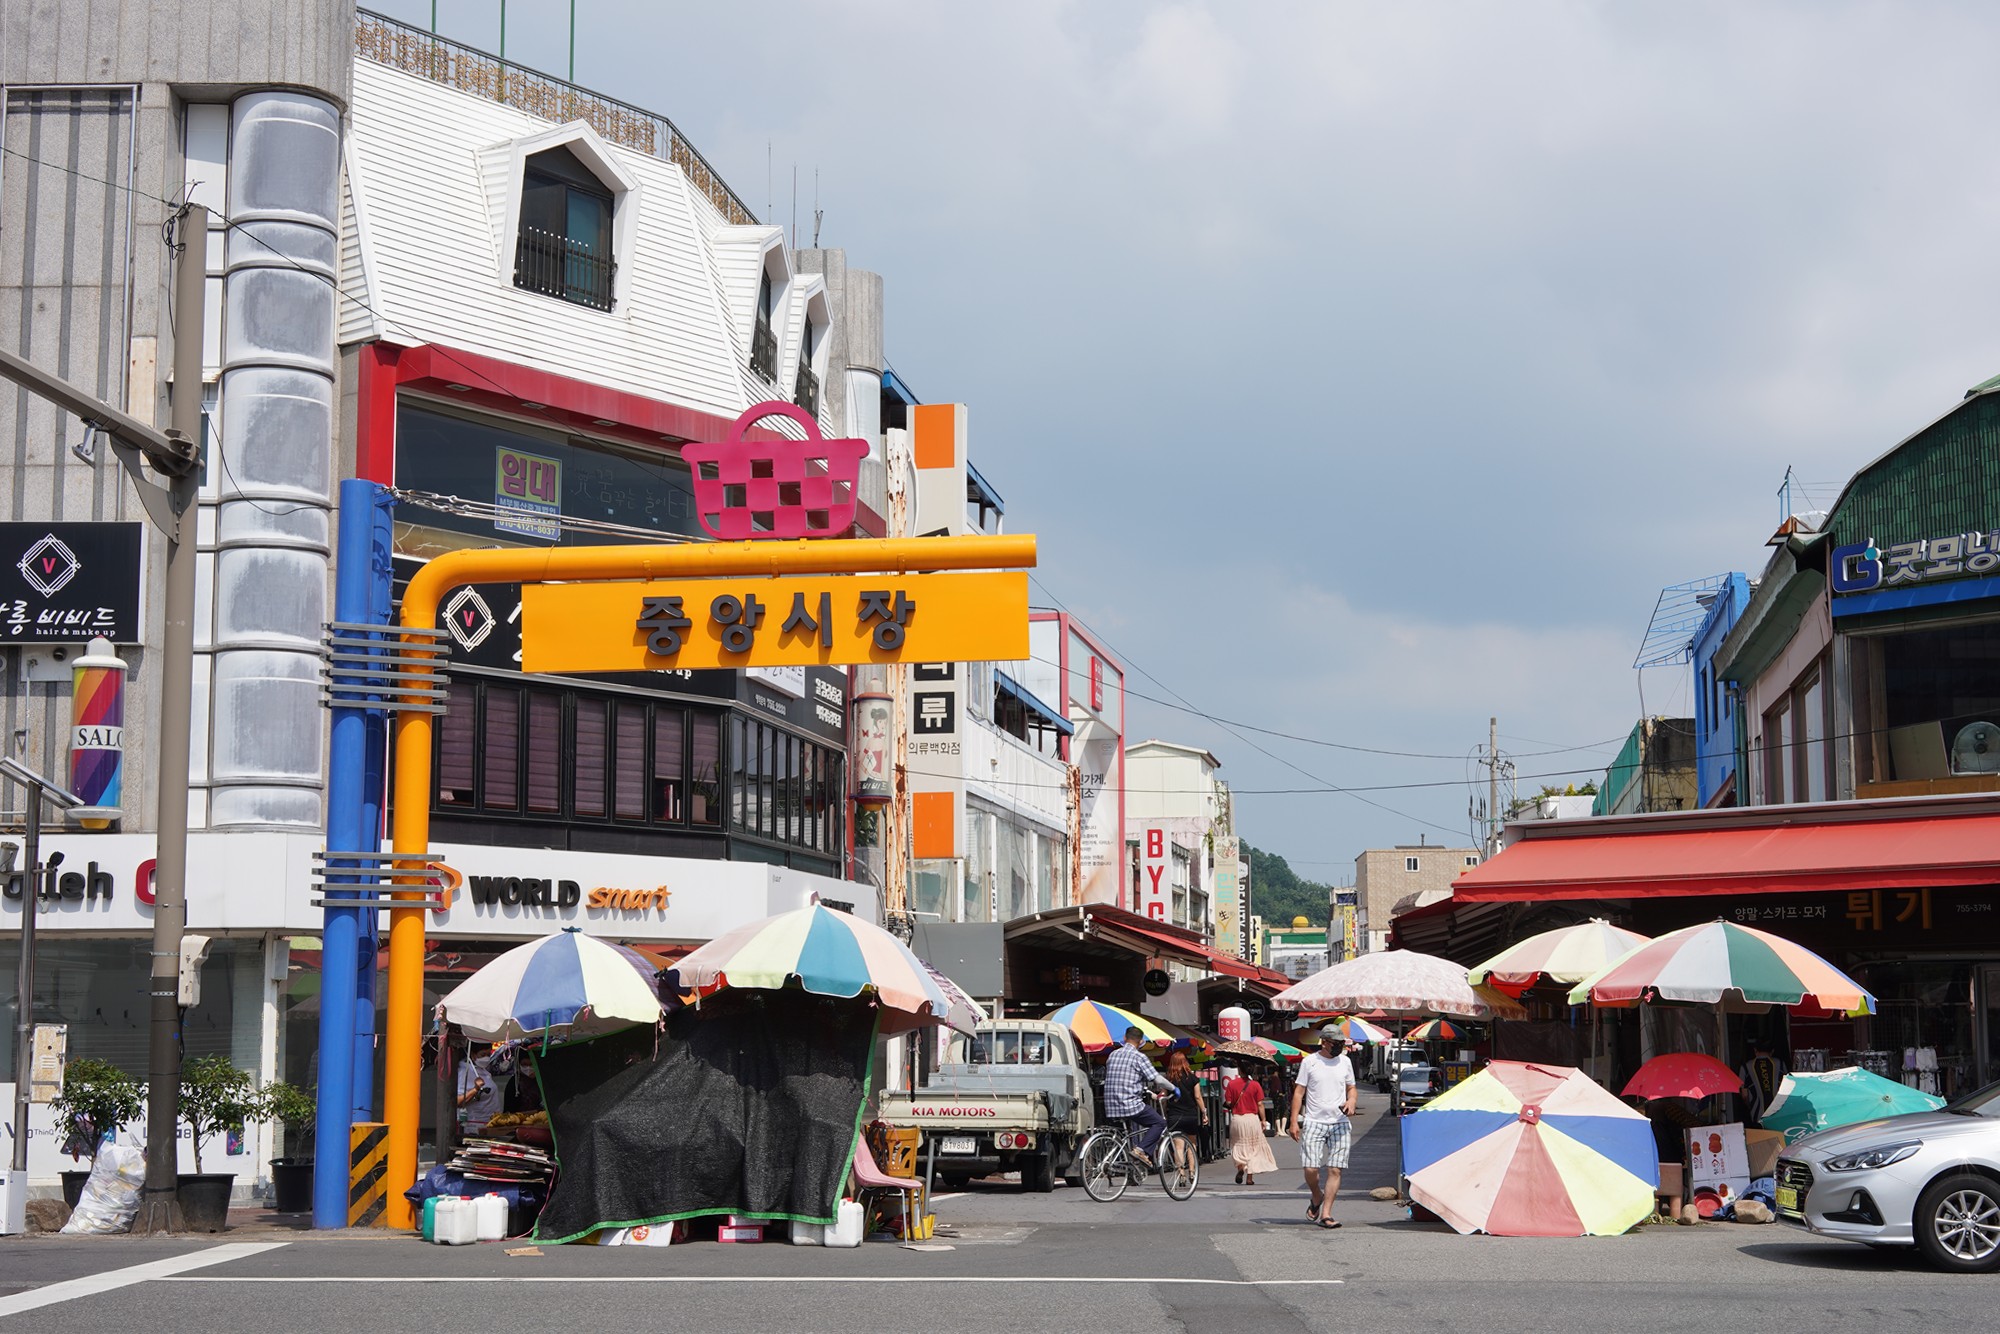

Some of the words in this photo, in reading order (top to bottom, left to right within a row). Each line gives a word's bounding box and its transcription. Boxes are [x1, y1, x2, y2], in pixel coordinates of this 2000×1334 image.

[502, 454, 556, 502] 임대
[41, 557, 57, 574] V
[37, 607, 116, 625] 비비드
[462, 610, 475, 627] V
[636, 590, 916, 656] 중앙시장
[103, 629, 116, 637] up
[908, 742, 961, 755] 의류백화점
[468, 876, 581, 908] WORLD
[586, 885, 673, 911] smart
[1956, 903, 1992, 913] 755-3794
[912, 1107, 935, 1116] KIA
[939, 1107, 996, 1117] MOTORS
[34, 1128, 54, 1136] ThinQ
